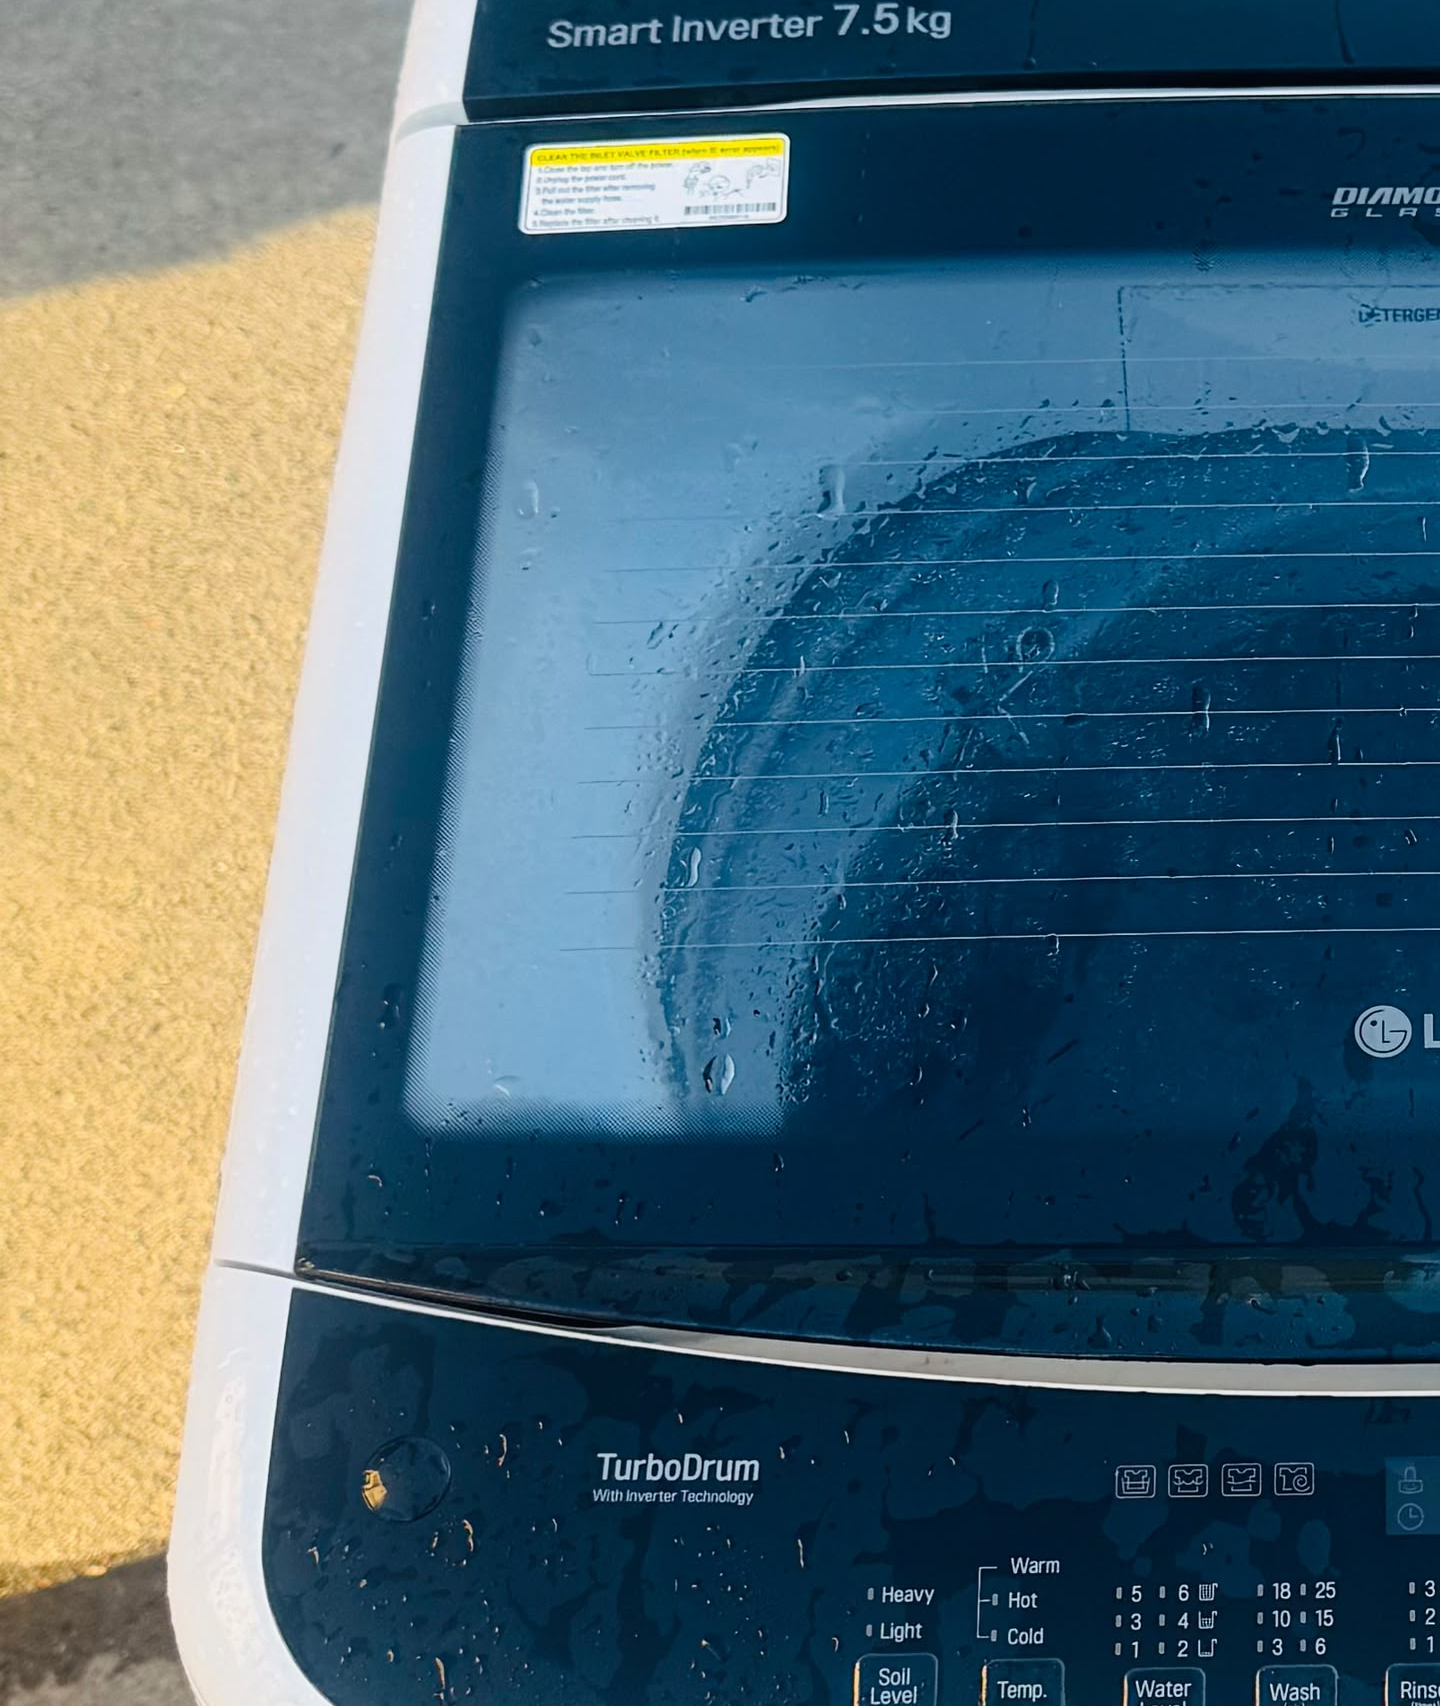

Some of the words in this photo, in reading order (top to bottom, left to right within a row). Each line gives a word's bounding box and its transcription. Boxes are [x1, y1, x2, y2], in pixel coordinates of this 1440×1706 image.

[548, 20, 663, 48] Smart
[673, 14, 823, 43] Inverter
[618, 150, 646, 158] VALVE
[597, 1453, 760, 1482] TurboDrum
[593, 1489, 623, 1503] With
[626, 1490, 677, 1503] Inverter
[681, 1489, 754, 1506] Technology
[1010, 1557, 1061, 1574] Warm
[882, 1586, 934, 1605] Heavy
[1131, 1585, 1143, 1602] 5
[1177, 1584, 1189, 1602] 6
[1272, 1582, 1291, 1600] 18
[1315, 1581, 1336, 1598] 25
[1424, 1580, 1436, 1597] 3
[1008, 1591, 1038, 1609] Hot
[1130, 1613, 1142, 1630] 3
[1177, 1613, 1189, 1630] 4
[1272, 1610, 1291, 1628] 10
[1315, 1609, 1334, 1626] 15
[1425, 1608, 1436, 1625] 2
[880, 1622, 922, 1641] Light
[1007, 1627, 1044, 1645] Cold
[1131, 1641, 1139, 1658] 1
[1177, 1640, 1189, 1657] 2
[1271, 1637, 1283, 1655] 3
[1314, 1637, 1326, 1655] 6
[1426, 1636, 1435, 1653] 1
[879, 1668, 911, 1686] Soil
[870, 1687, 918, 1705] Level
[997, 1680, 1048, 1701] Temp.
[1135, 1679, 1192, 1698] Water
[1269, 1682, 1321, 1701] Wash
